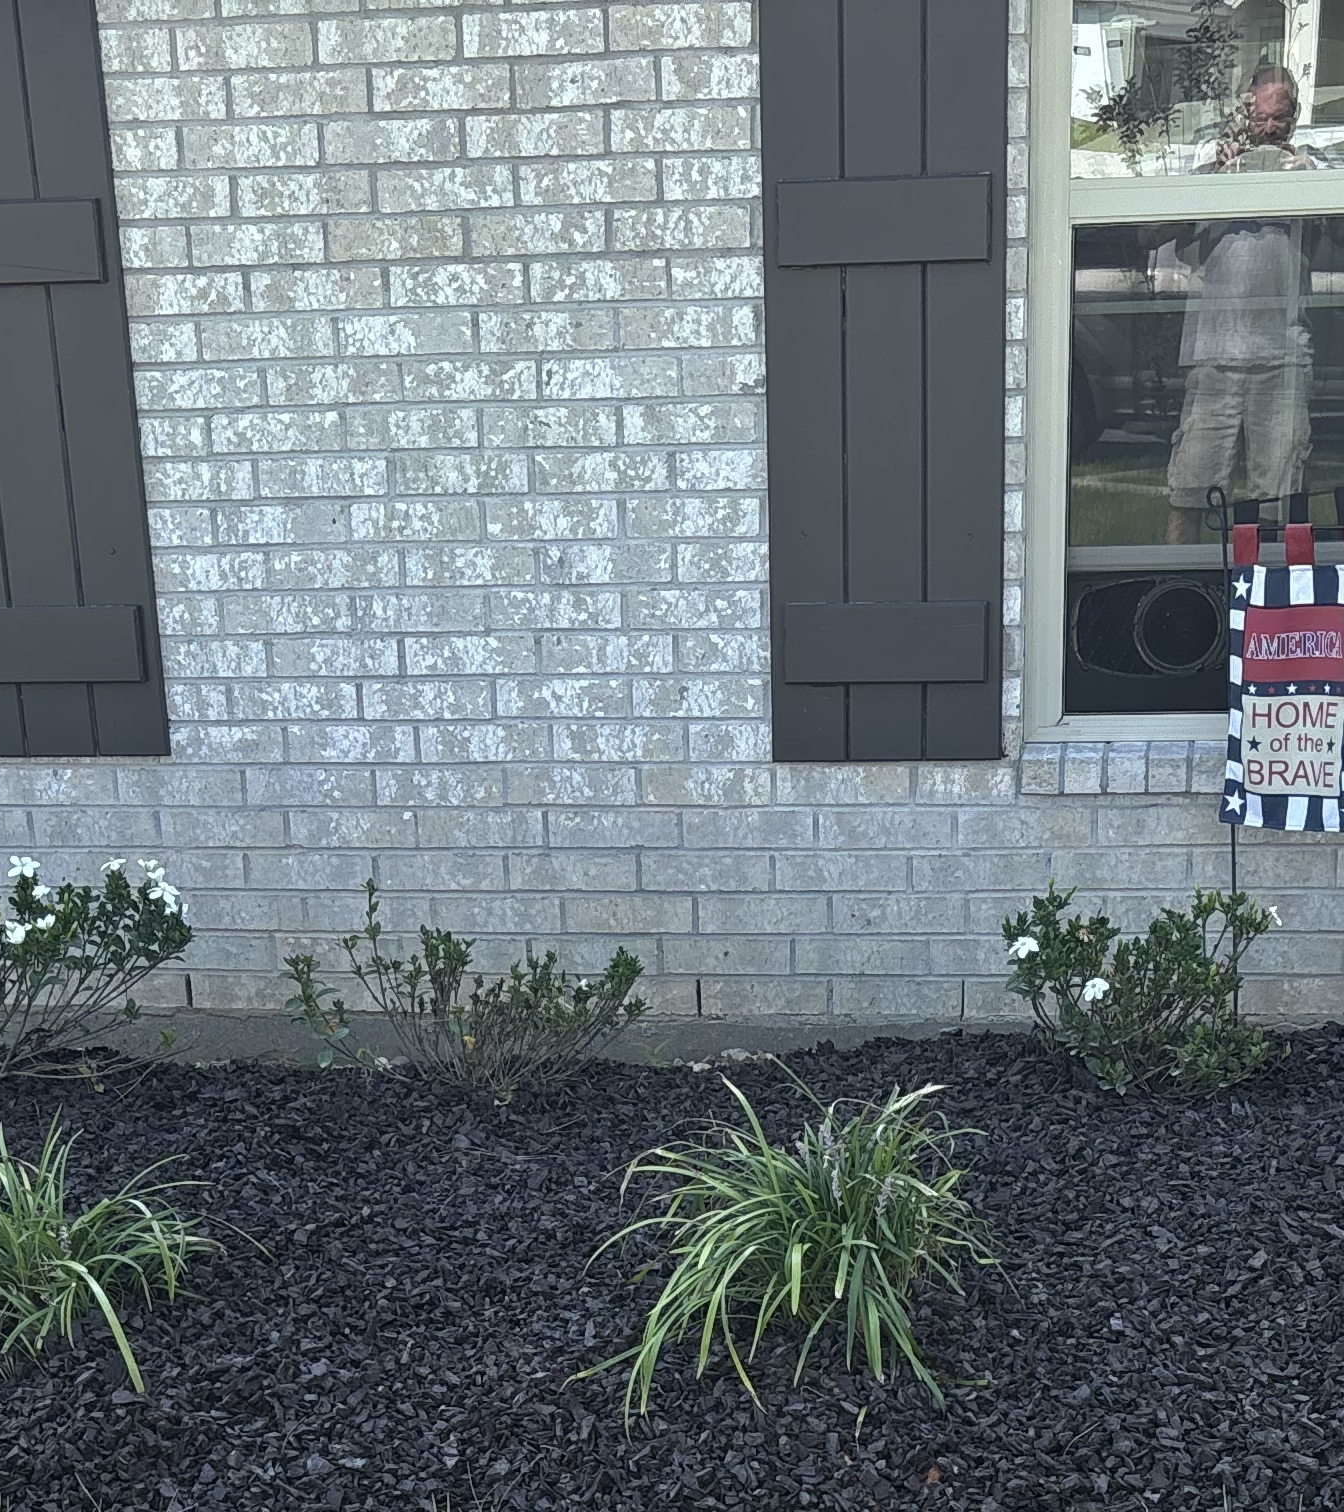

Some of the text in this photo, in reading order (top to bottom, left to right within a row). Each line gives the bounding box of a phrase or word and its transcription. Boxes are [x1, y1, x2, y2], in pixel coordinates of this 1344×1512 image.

[1246, 631, 1343, 660] AMERICA
[1251, 701, 1339, 729] HOME
[1269, 733, 1324, 753] of the
[1247, 759, 1334, 789] BRAVE
